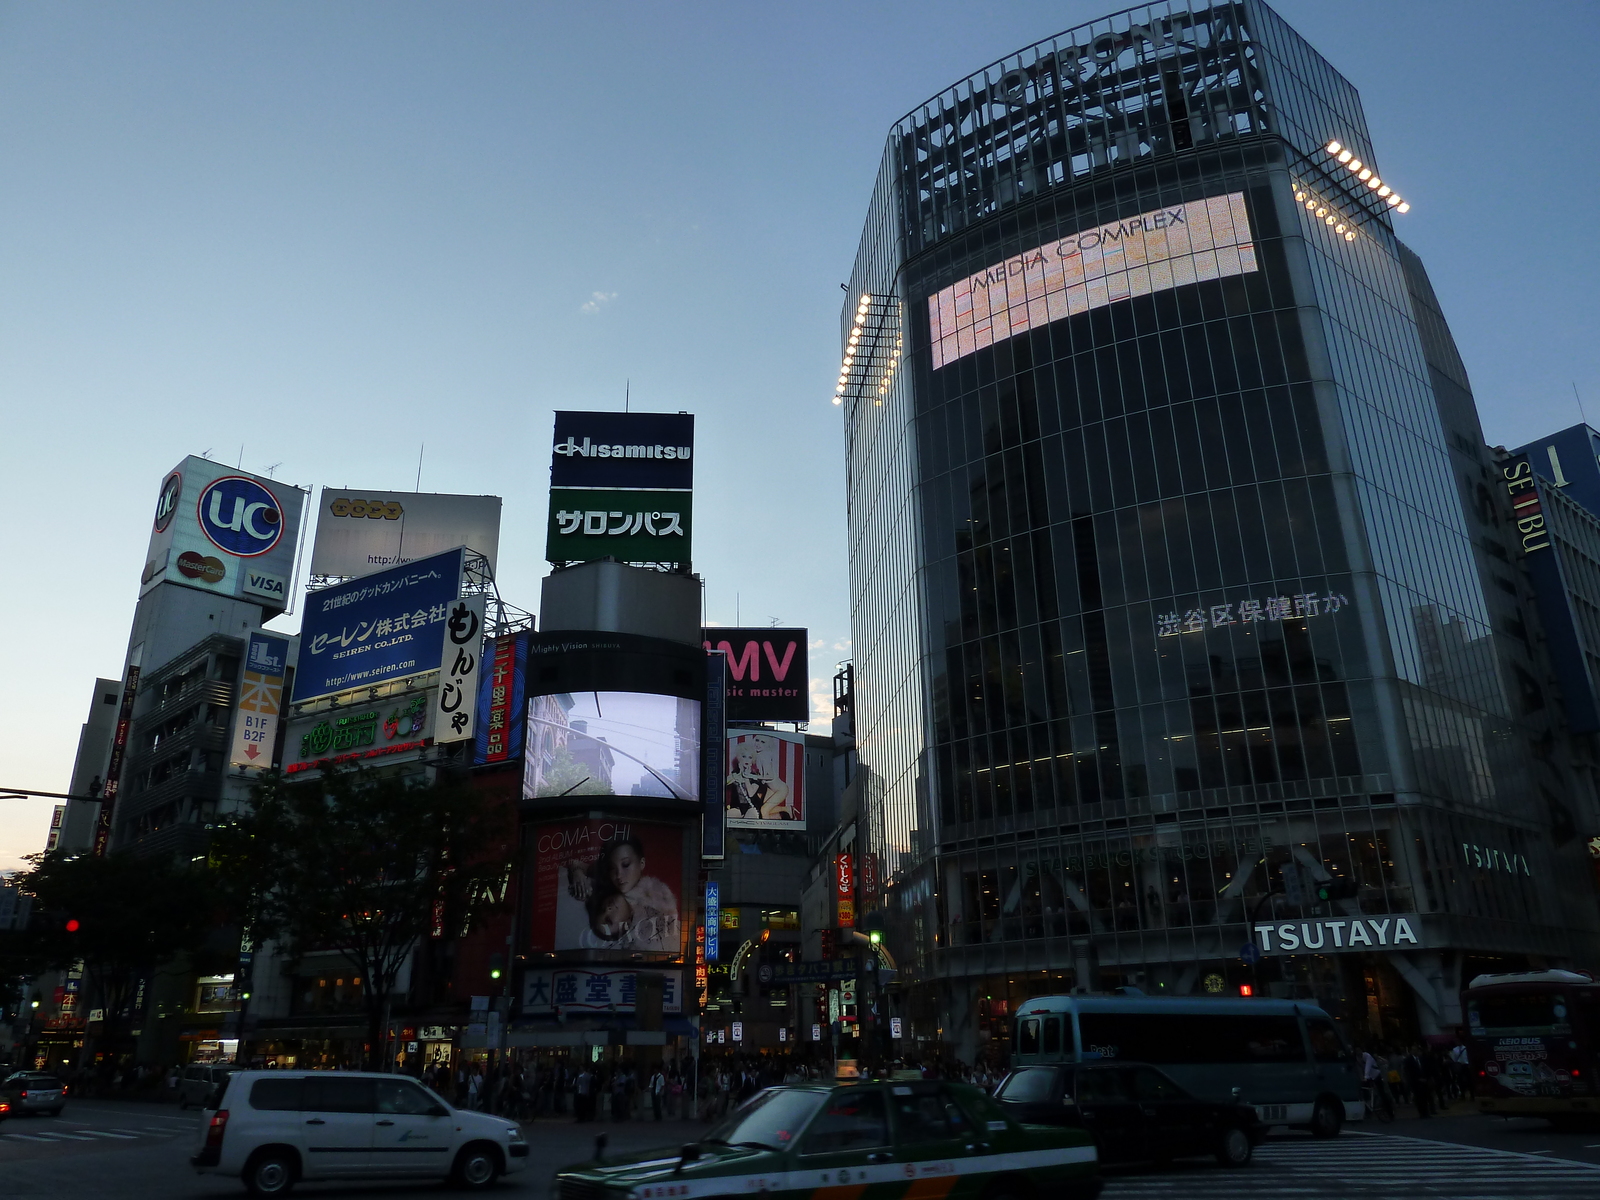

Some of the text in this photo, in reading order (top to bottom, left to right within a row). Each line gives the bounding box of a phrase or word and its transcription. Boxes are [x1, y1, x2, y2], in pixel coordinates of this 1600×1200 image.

[972, 208, 1185, 293] MEDIA COMPLEX
[552, 436, 692, 460] Hisamitsu
[334, 503, 399, 516] TOPY
[1503, 461, 1551, 553] SEIBU
[555, 509, 684, 537] サロンパス
[178, 559, 225, 578] MasterCard
[249, 573, 283, 594] VISA
[322, 570, 442, 612] 21世紀のグッドカンパニーへ。
[308, 603, 446, 655] セーレン株式会社
[332, 644, 372, 660] SEIREN
[531, 644, 560, 655] Mighty
[561, 641, 588, 653] Vision
[702, 640, 798, 682] MV
[325, 658, 416, 687] http://www.seiren.com
[240, 673, 282, 712] 本
[487, 637, 512, 755] 三千里薬品
[749, 686, 799, 698] master
[243, 730, 266, 742] B2F
[246, 716, 268, 729] B1F
[537, 823, 631, 853] COMA-CHI
[1026, 836, 1274, 877] STARBUCKS COFFEE
[707, 885, 718, 957] 大盛堂商事ビル
[1254, 917, 1418, 951] TSUTAYA
[775, 960, 856, 976] 歩きタバコ禁止
[1521, 1037, 1541, 1045] BUS
